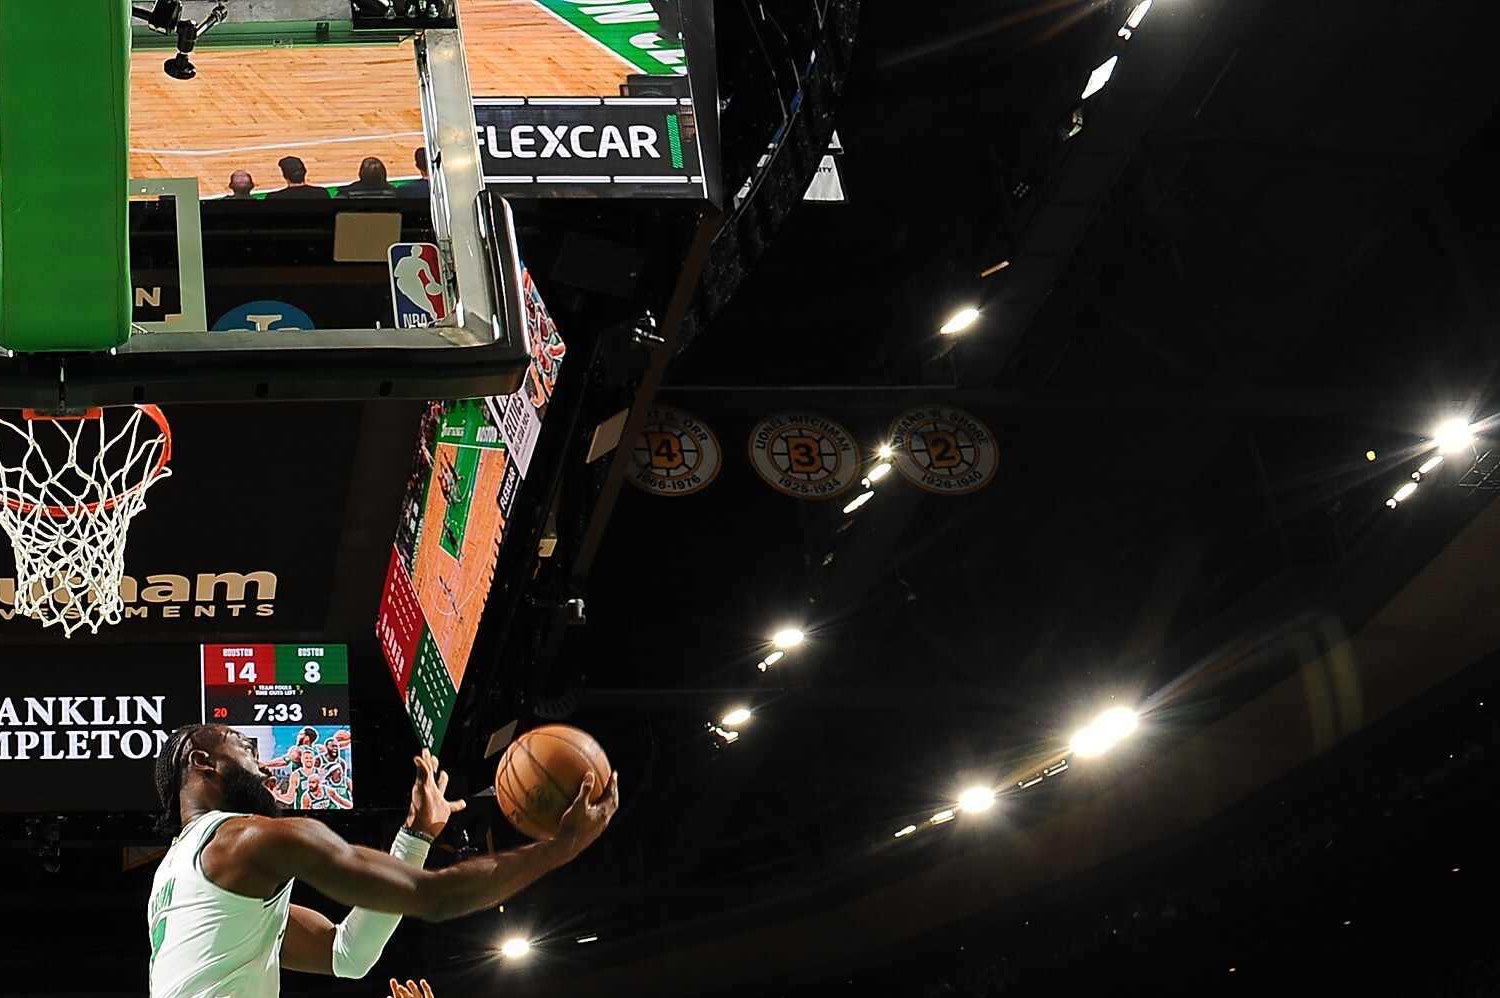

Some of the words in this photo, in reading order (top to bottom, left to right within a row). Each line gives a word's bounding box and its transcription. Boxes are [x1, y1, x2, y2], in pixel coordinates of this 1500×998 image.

[477, 124, 660, 159] FLEXCAR
[682, 418, 709, 443] ORR
[754, 418, 785, 451] LIONEL
[787, 414, 852, 453] HITCHMAN
[950, 411, 989, 446] SHORE
[654, 438, 677, 463] 4
[792, 443, 816, 467] 3
[930, 436, 957, 463] 2
[778, 476, 842, 494] 1925-1934
[920, 469, 983, 489] 1926-1940
[224, 662, 257, 683] 14
[304, 661, 321, 683] 8
[213, 708, 228, 718] 20
[253, 704, 302, 722] 7:33
[321, 706, 338, 717] 1st
